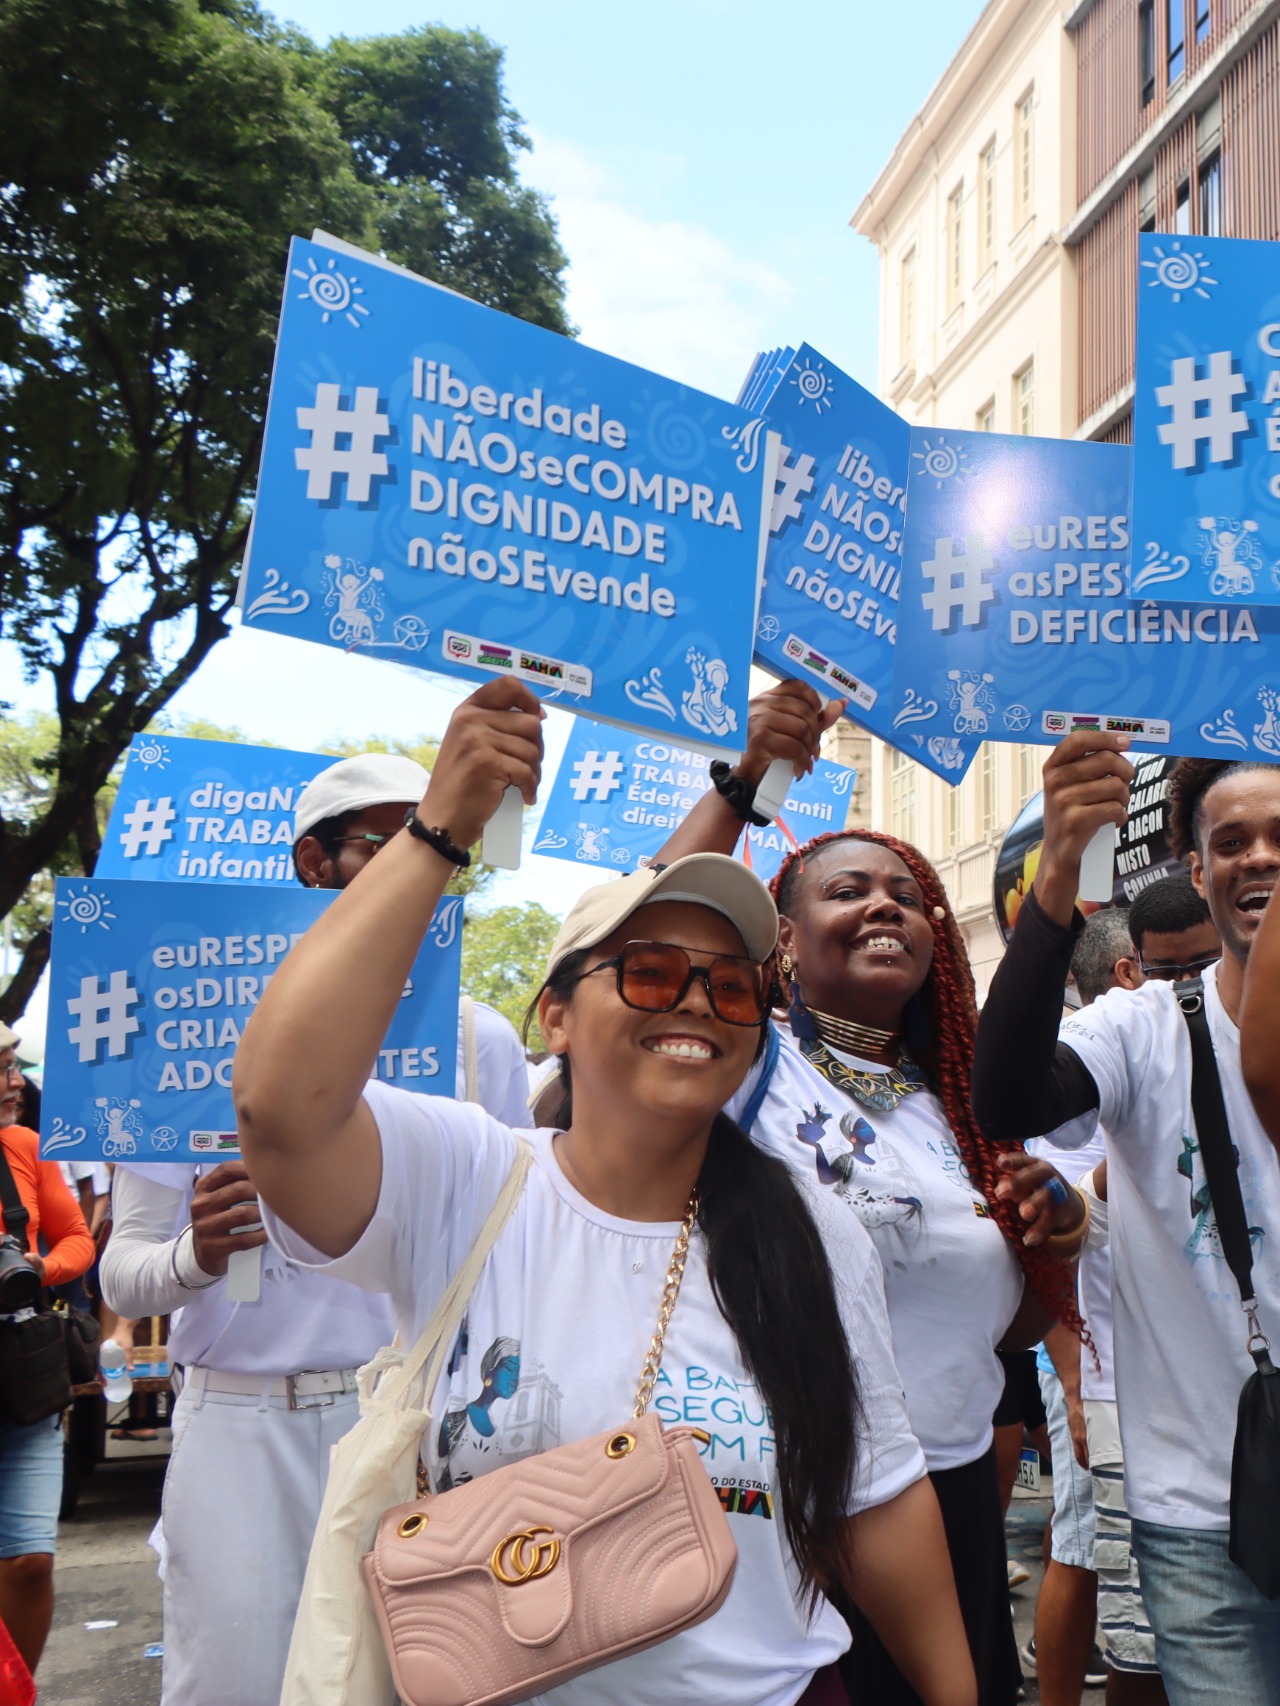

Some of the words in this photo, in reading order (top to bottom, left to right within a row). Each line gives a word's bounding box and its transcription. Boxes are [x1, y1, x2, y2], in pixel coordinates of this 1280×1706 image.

[412, 356, 628, 449] liberdade
[411, 413, 742, 531] NÃOseCOMPRA
[409, 469, 667, 563] DIGNIDADE
[407, 532, 677, 617] nãoSEvende
[1007, 562, 1131, 598] asPES
[1010, 599, 1260, 645] DEFICIÊNCIA
[635, 743, 714, 772] COMB
[1134, 757, 1167, 787] TUDO
[631, 763, 715, 792] TRABA
[1127, 807, 1164, 843] BACON
[177, 849, 296, 881] infantil
[1116, 843, 1151, 876] MISTO
[155, 1017, 254, 1051] CRIA
[721, 1477, 736, 1487] DO
